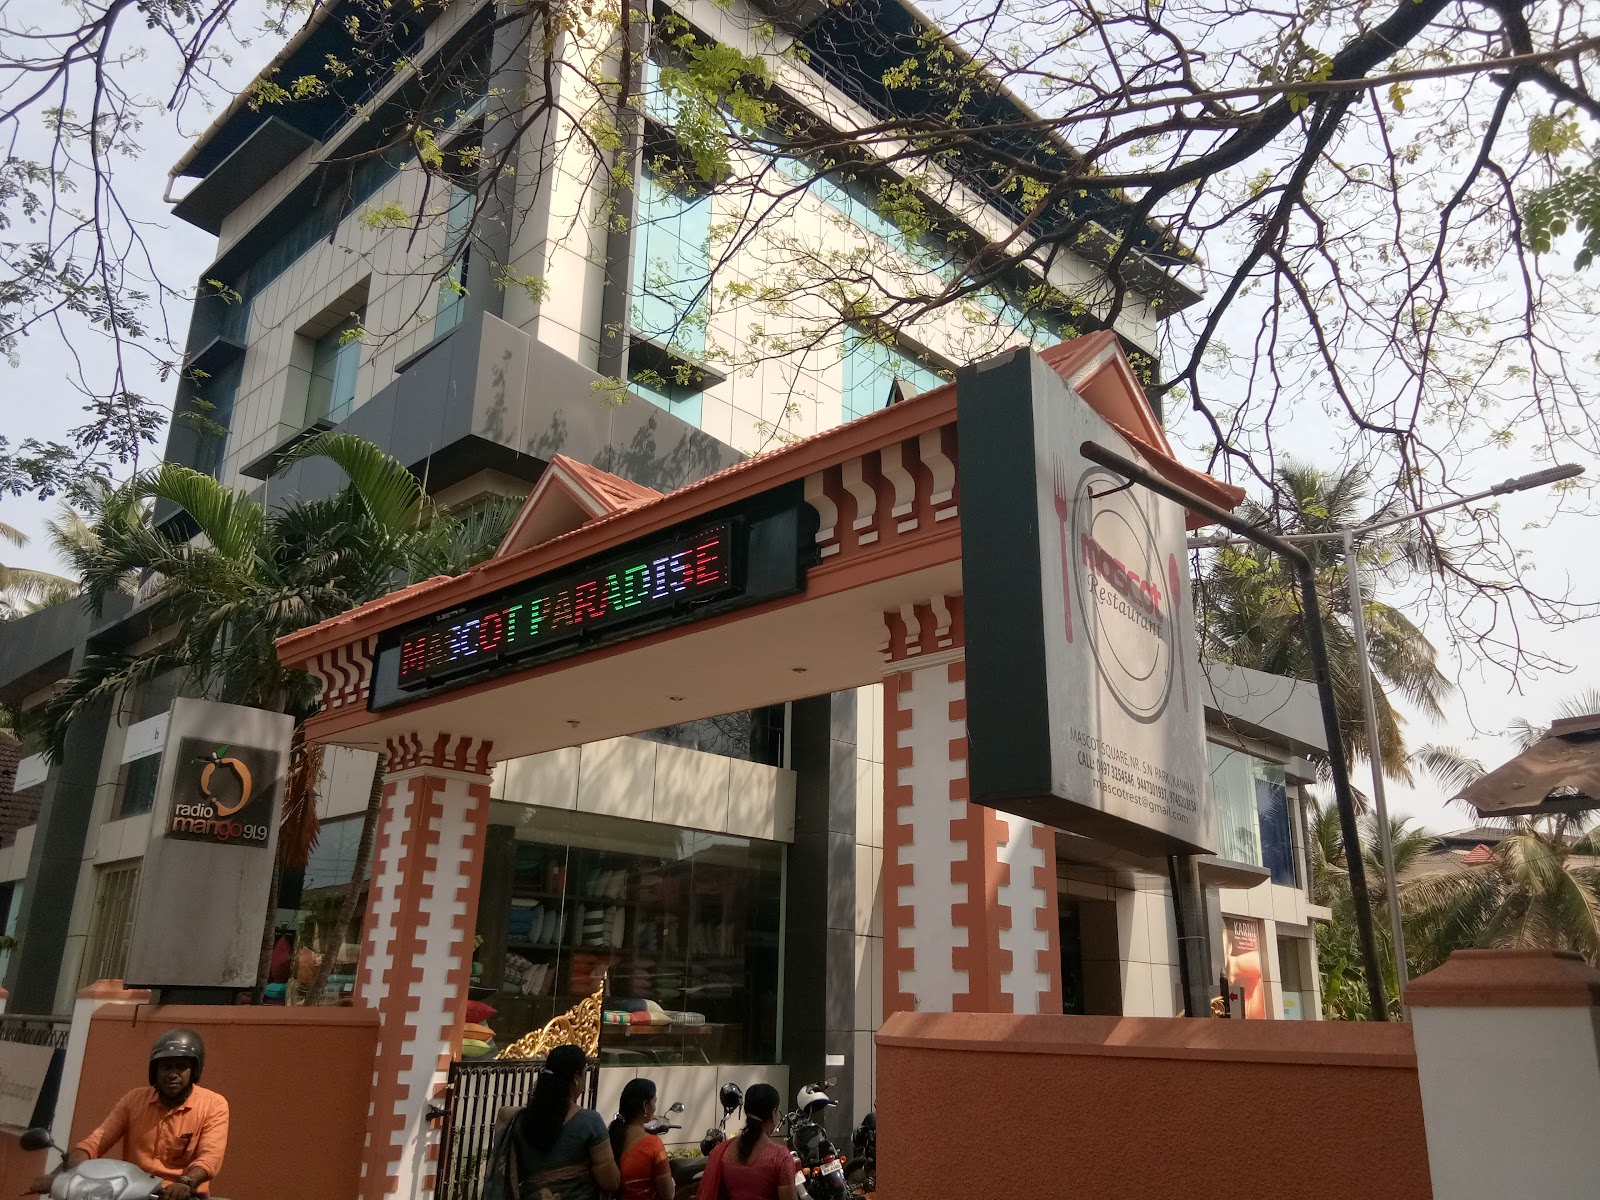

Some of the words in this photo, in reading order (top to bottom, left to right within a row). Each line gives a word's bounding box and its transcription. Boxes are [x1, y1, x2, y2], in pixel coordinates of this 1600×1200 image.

[1081, 532, 1162, 622] mascot
[401, 603, 523, 675] MASCOT
[530, 540, 720, 635] PARADISE
[1087, 573, 1163, 638] Restaurant
[1070, 727, 1100, 752] MASCOT
[1078, 750, 1095, 770] CALL:
[1096, 759, 1110, 776] 0497
[175, 803, 214, 818] radio
[1092, 778, 1189, 825] mascotrest@gmail.com
[172, 816, 243, 840] mango
